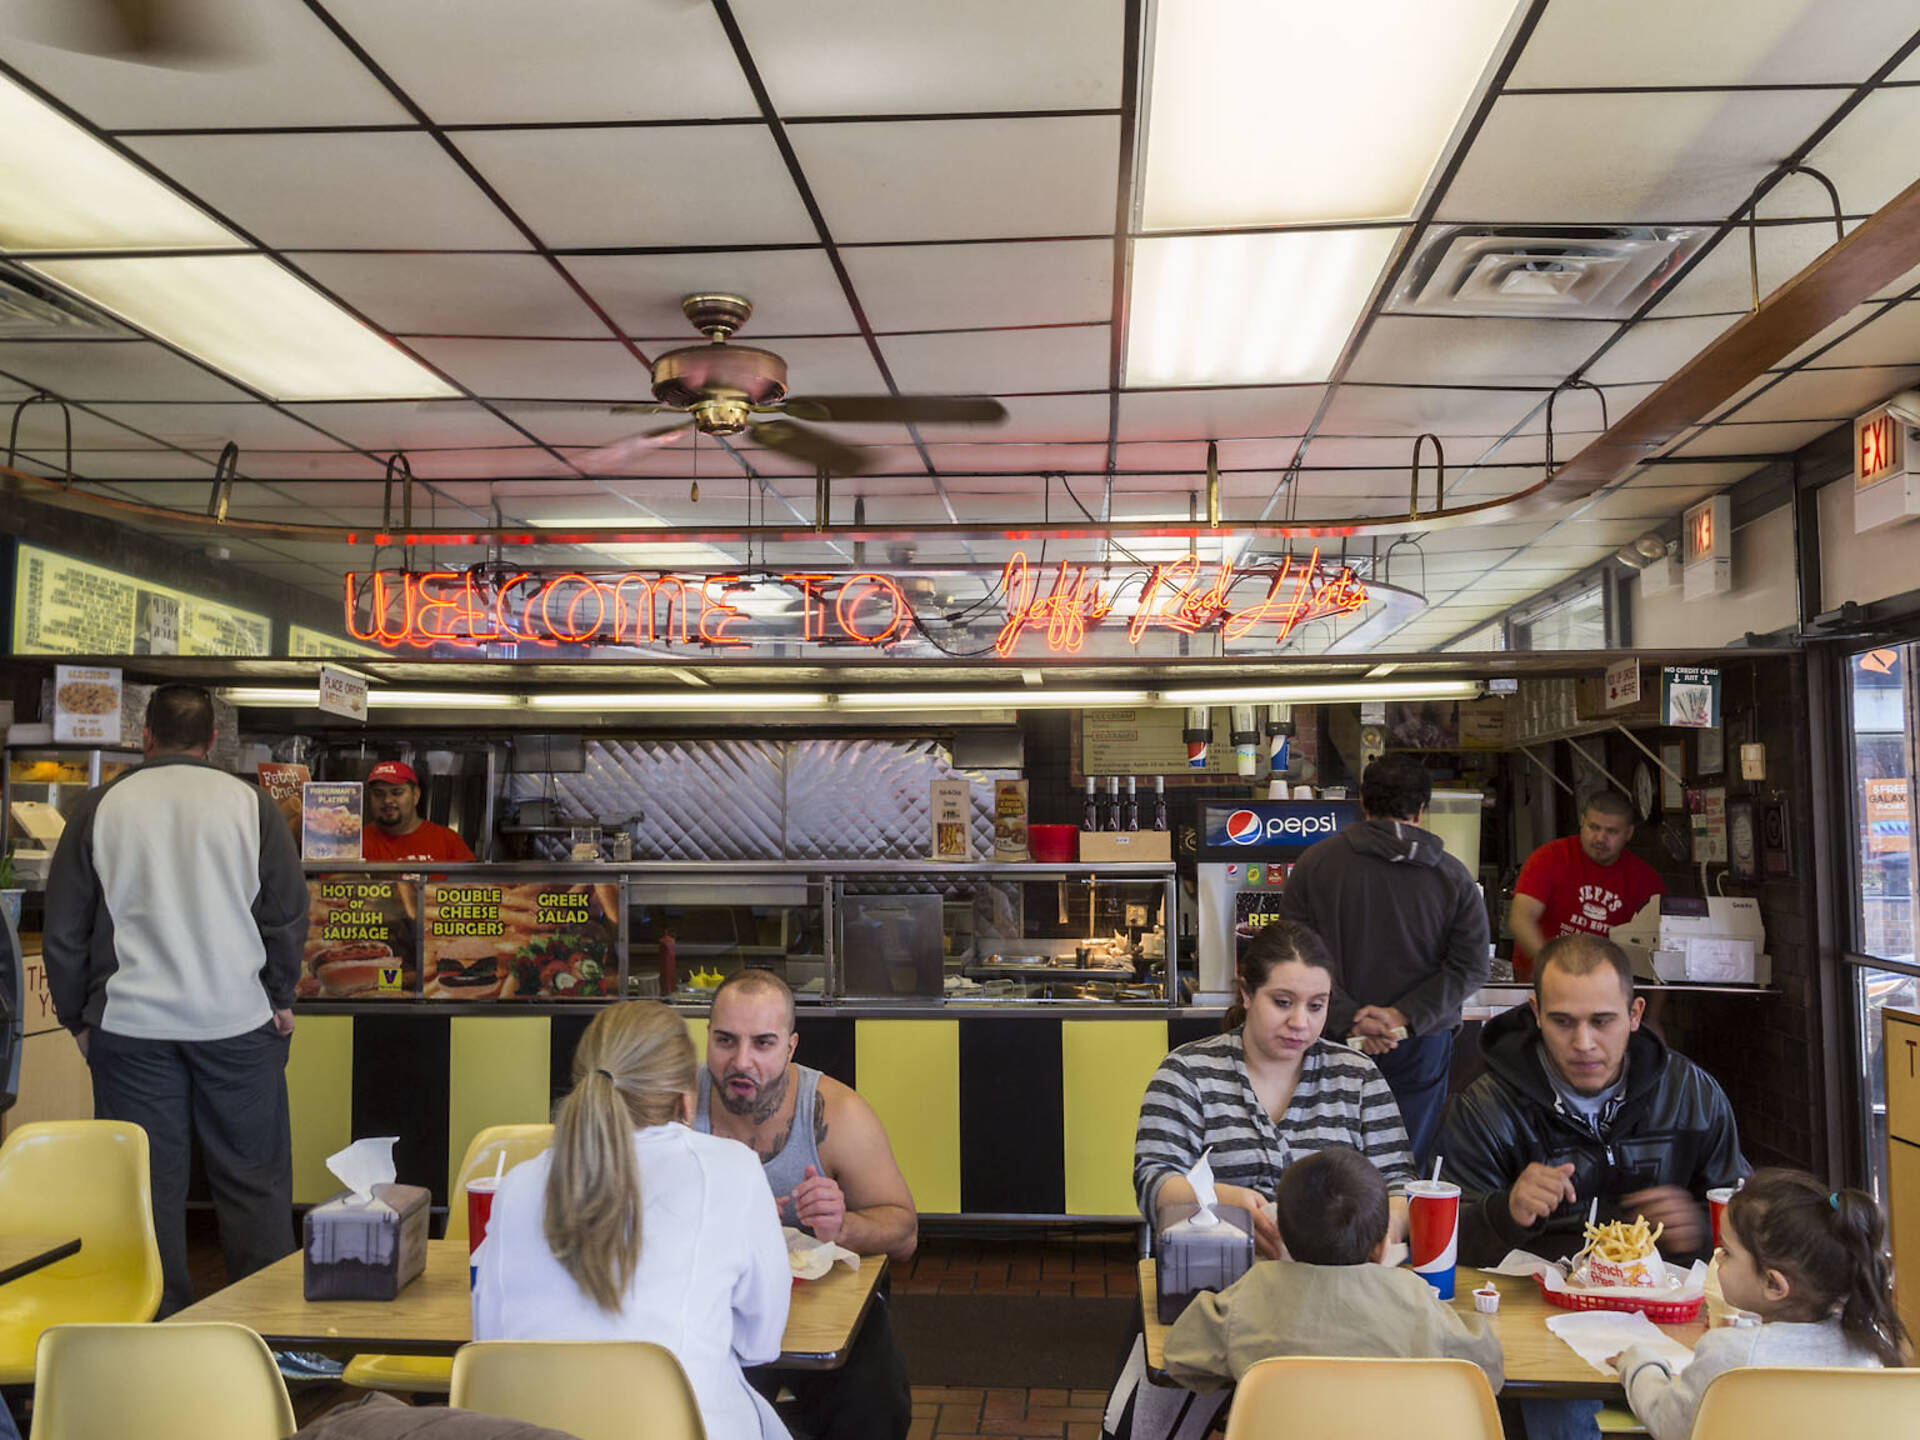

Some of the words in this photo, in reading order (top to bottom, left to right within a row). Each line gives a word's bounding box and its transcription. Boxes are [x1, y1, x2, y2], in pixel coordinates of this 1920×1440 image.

[1861, 414, 1896, 479] EXIT
[345, 570, 741, 644] WELCOME
[780, 572, 903, 644] TO
[1127, 553, 1231, 645] Red
[1222, 545, 1367, 645] Hots
[325, 676, 344, 692] PLACE
[261, 769, 301, 787] Fetch
[271, 783, 300, 801] One!
[1266, 812, 1336, 838] pepsi
[322, 884, 353, 897] HOT
[356, 884, 392, 897] DOG
[436, 889, 501, 903] DOUBLE
[348, 899, 363, 909] or
[537, 894, 588, 907] GREEK
[329, 911, 383, 924] POLISH
[439, 906, 498, 919] CHEESE
[536, 910, 588, 923] SALAD
[322, 927, 389, 941] SAUSAGE
[432, 922, 504, 935] BURGERS
